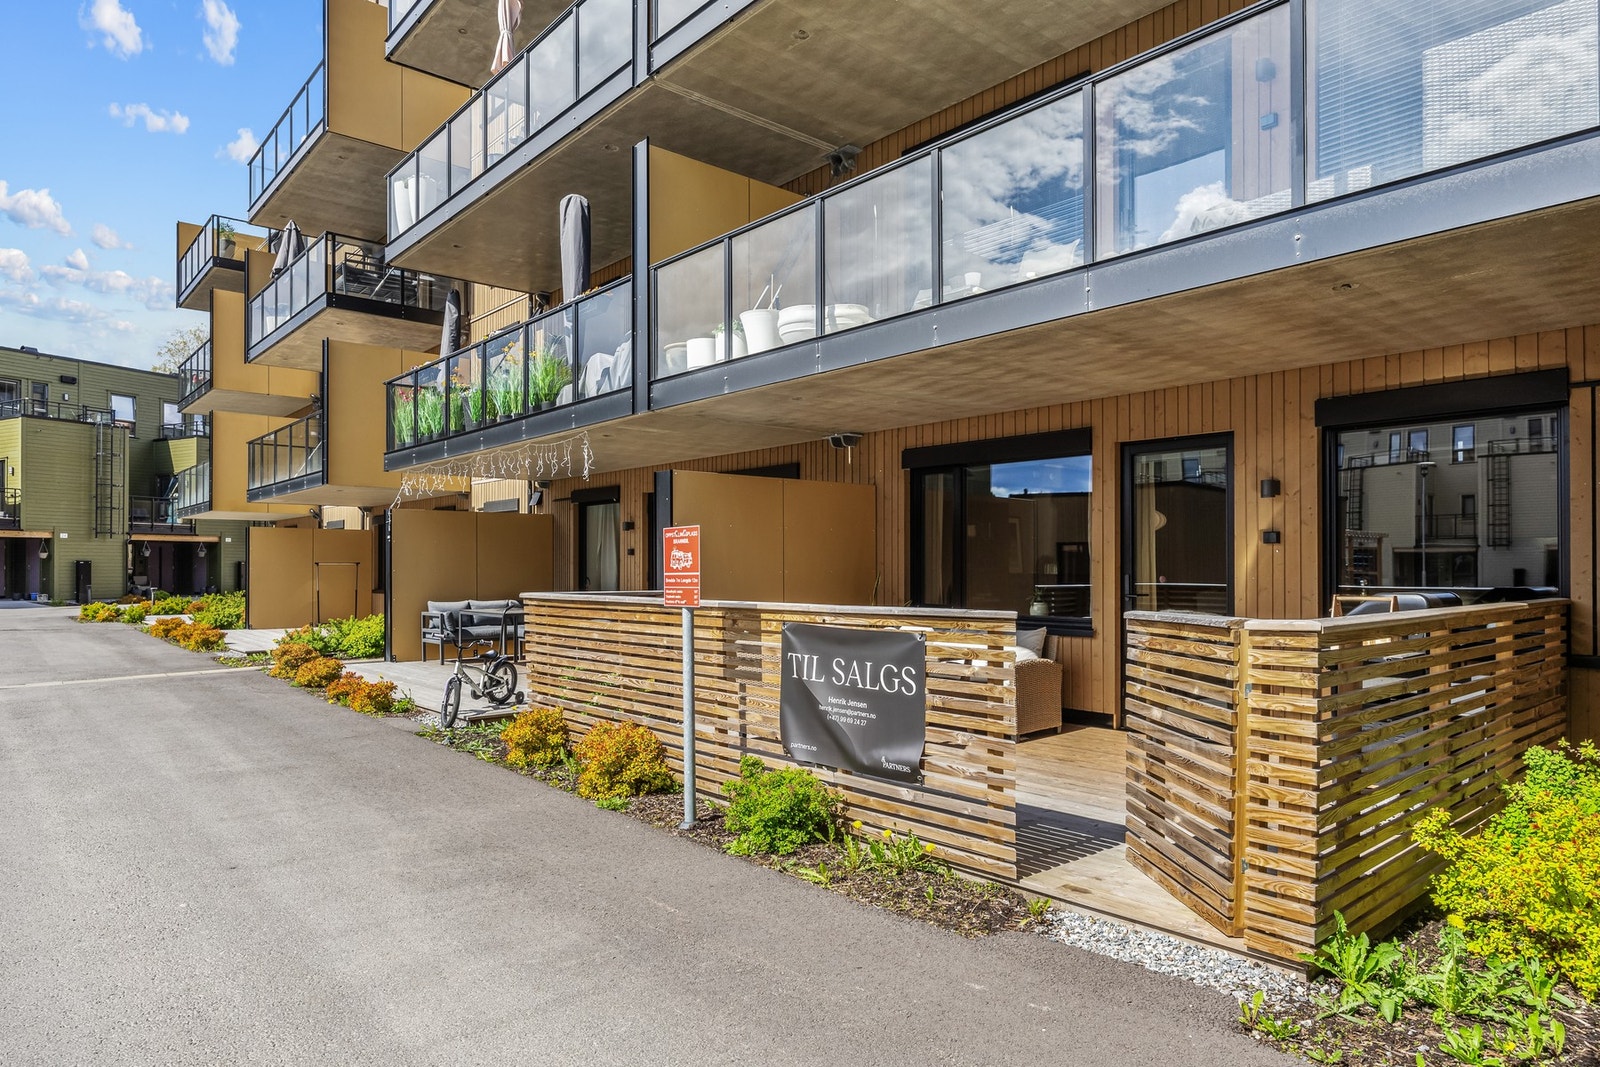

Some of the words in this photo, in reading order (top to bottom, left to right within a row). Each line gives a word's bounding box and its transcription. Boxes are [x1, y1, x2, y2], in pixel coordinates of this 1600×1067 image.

[787, 652, 825, 682] TIL
[831, 657, 917, 696] SALGS
[828, 695, 846, 706] Henrik
[847, 699, 868, 709] Jensen
[790, 742, 818, 752] partners.no
